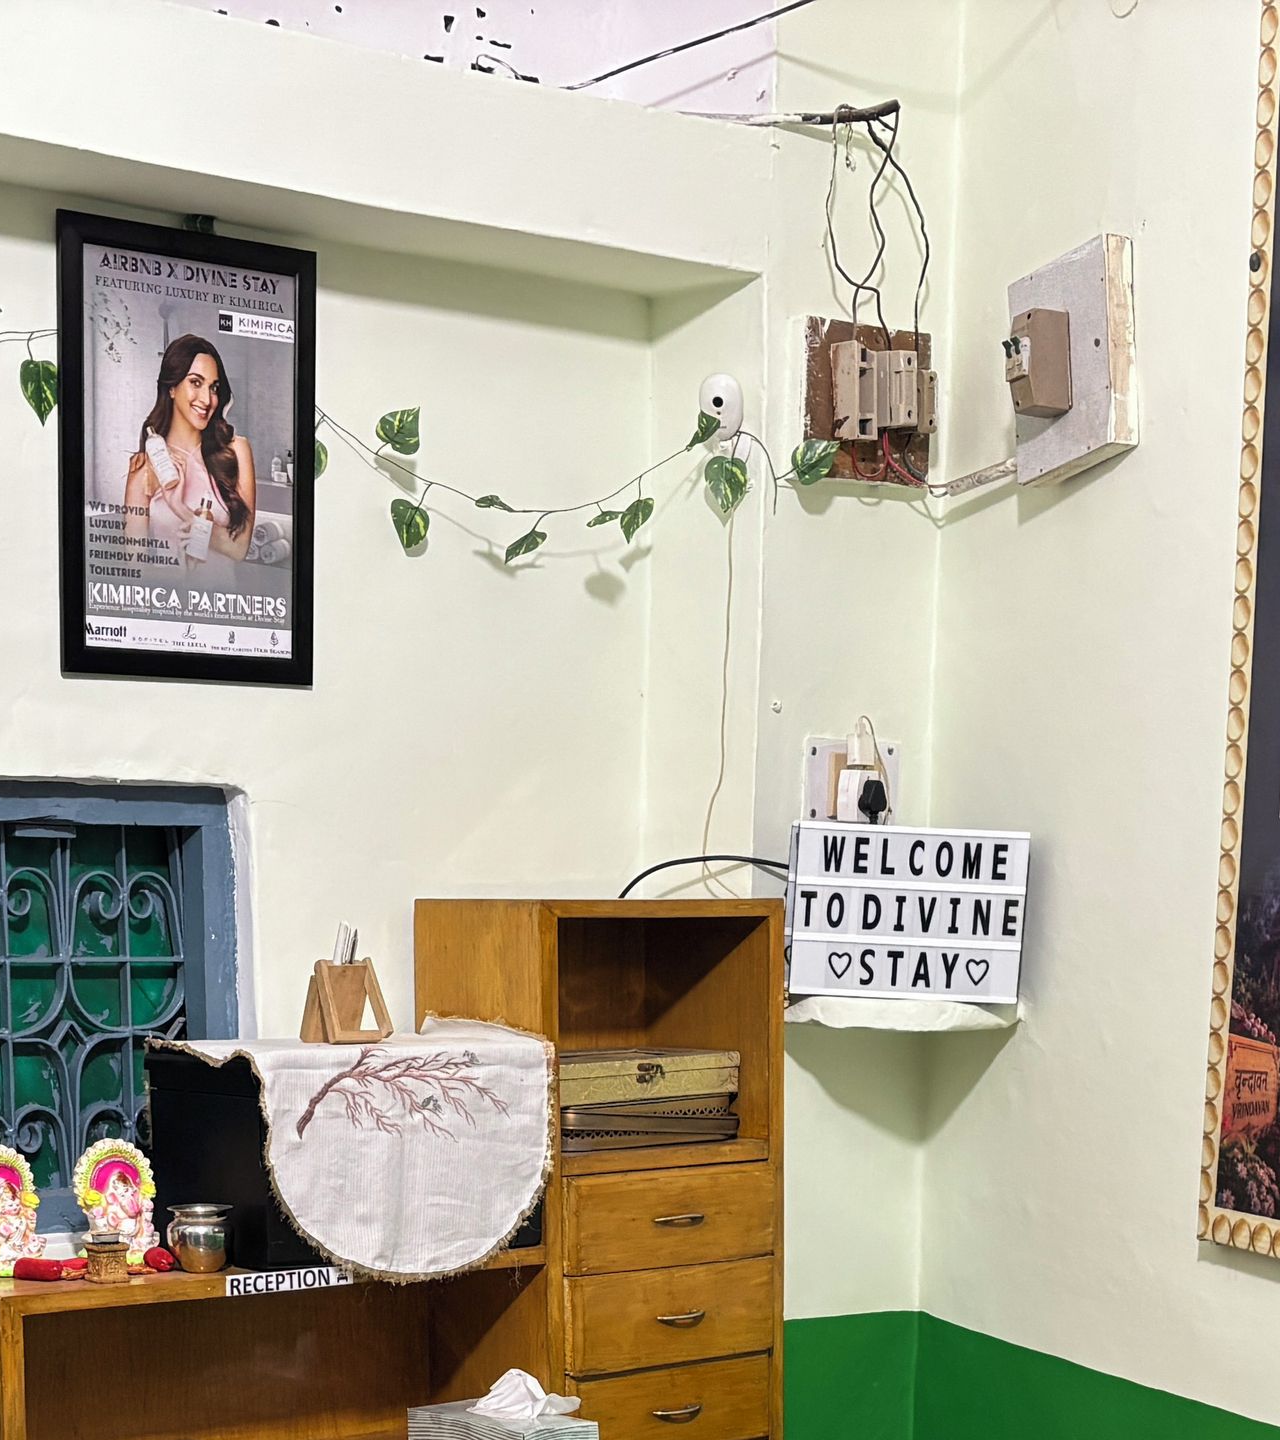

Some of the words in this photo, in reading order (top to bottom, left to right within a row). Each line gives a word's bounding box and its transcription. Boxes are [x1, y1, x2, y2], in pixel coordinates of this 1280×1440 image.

[99, 252, 162, 276] AIRBNB
[167, 262, 178, 280] X
[184, 266, 237, 289] DIVINE
[243, 274, 280, 295] STAY
[95, 275, 162, 295] FEATURING
[165, 286, 209, 302] LUXURY
[213, 294, 225, 304] BY
[229, 296, 284, 313] KIMIRICA
[239, 317, 294, 333] KIMIRICA
[89, 582, 181, 609] KIMIRICA
[189, 591, 286, 618] PARTNERS
[823, 835, 1008, 880] WELCOME
[800, 891, 845, 928] TO
[862, 894, 1019, 936] DIVINE
[859, 949, 959, 989] STAY
[230, 1269, 330, 1296] RECEPTION
